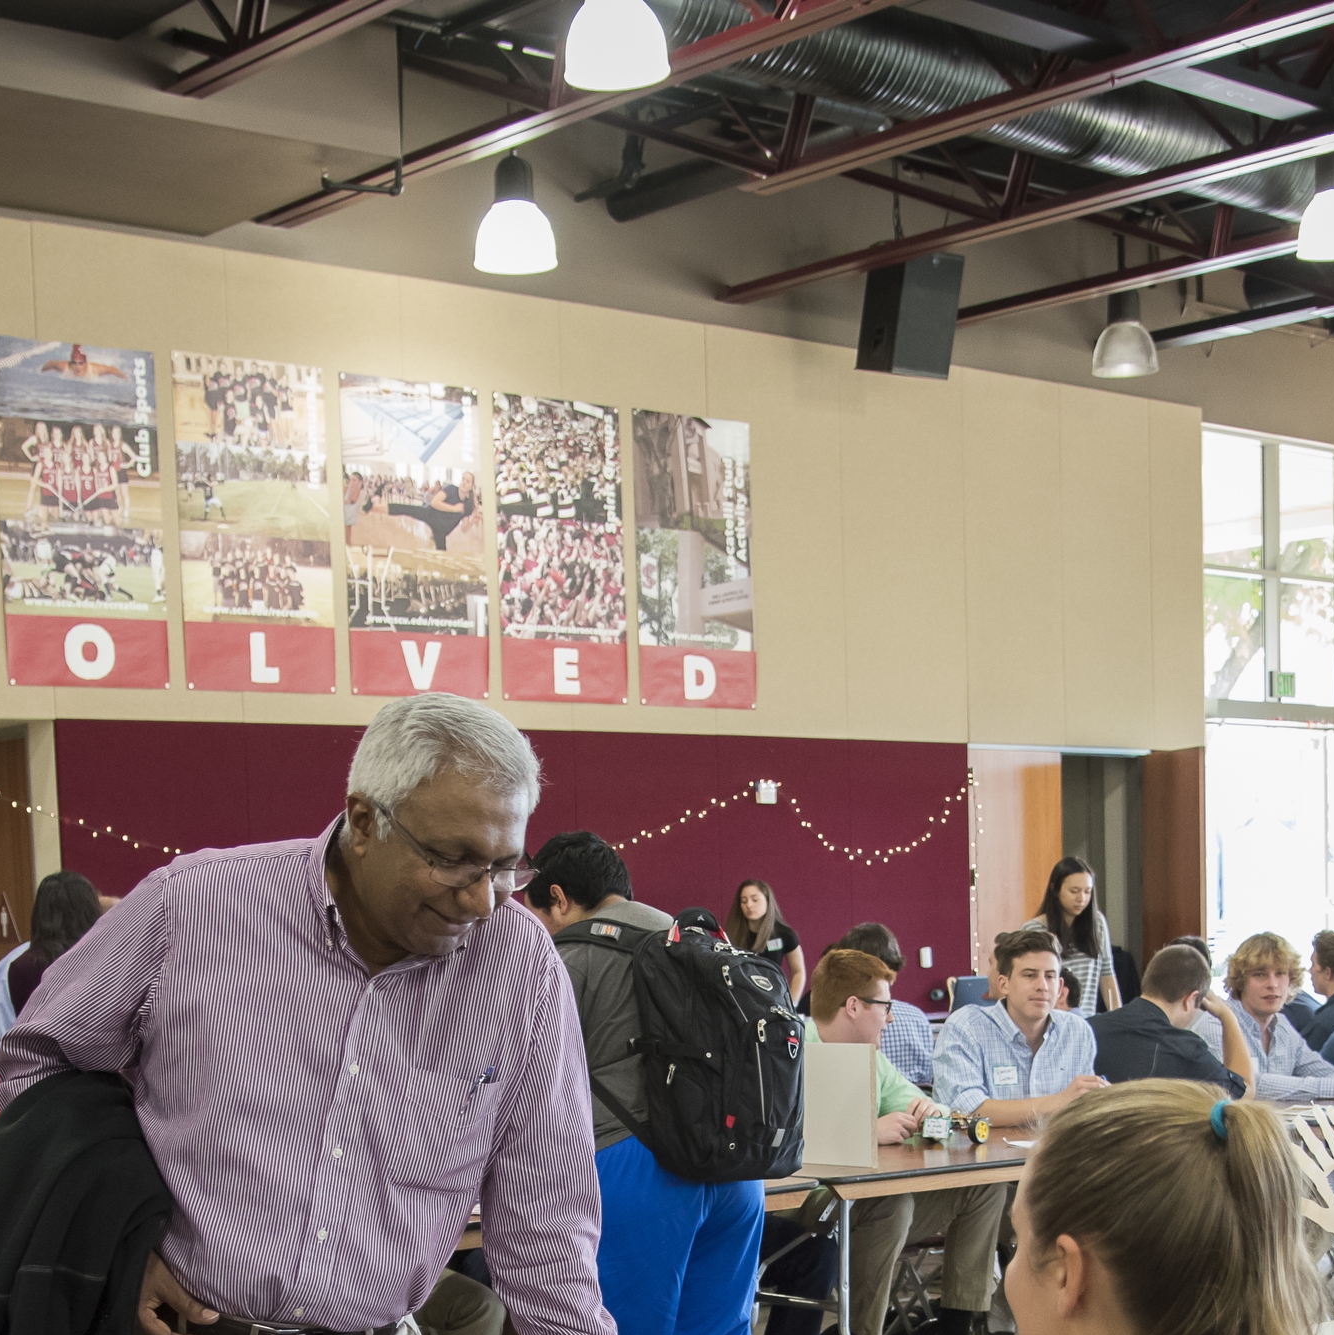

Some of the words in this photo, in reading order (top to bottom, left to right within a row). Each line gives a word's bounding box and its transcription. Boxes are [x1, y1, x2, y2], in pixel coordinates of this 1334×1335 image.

[133, 356, 153, 426] Sports
[134, 428, 152, 478] Club
[63, 623, 116, 681] O
[249, 631, 280, 684] L
[400, 639, 443, 691] V
[553, 646, 581, 696] E
[683, 654, 717, 701] D
